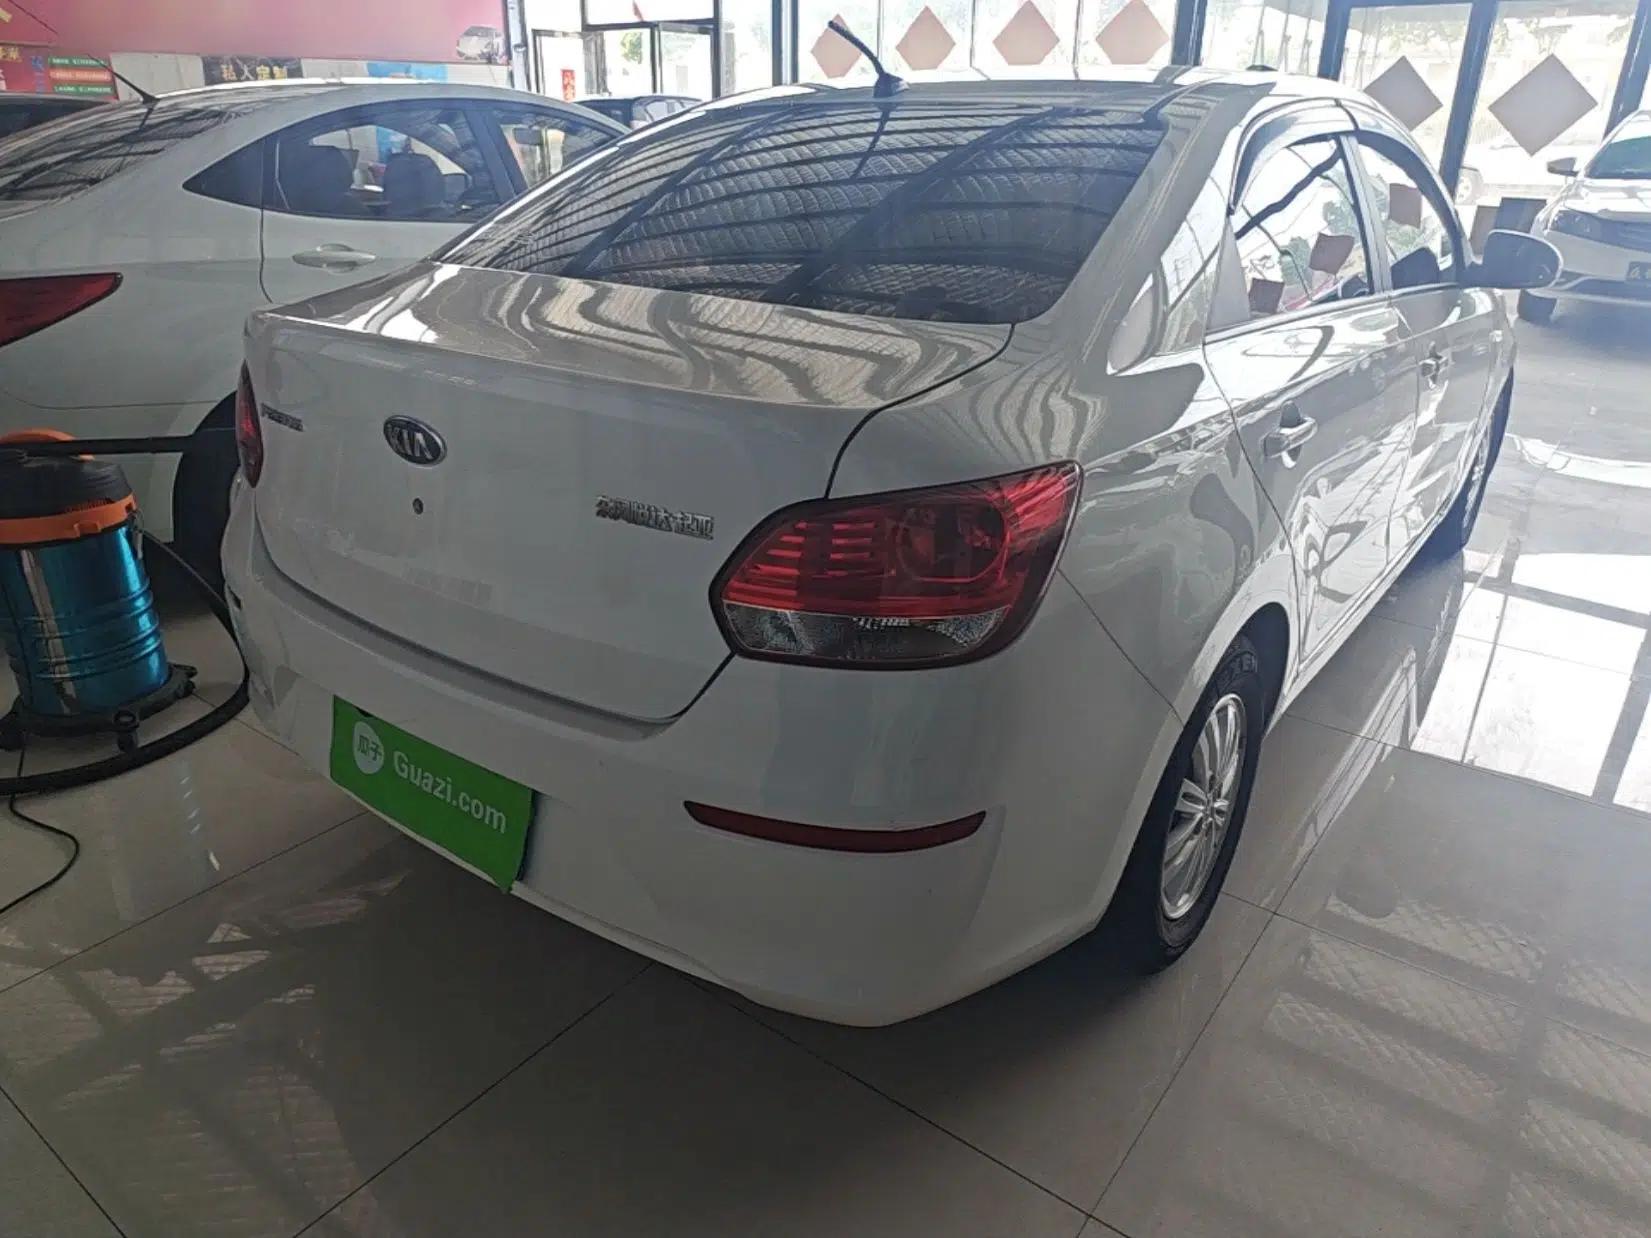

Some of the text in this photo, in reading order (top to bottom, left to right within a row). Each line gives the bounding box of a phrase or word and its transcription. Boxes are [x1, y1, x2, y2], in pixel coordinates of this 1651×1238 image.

[385, 422, 435, 460] KIA
[359, 735, 383, 762] 瓜子
[394, 751, 507, 833] Guazi.com
